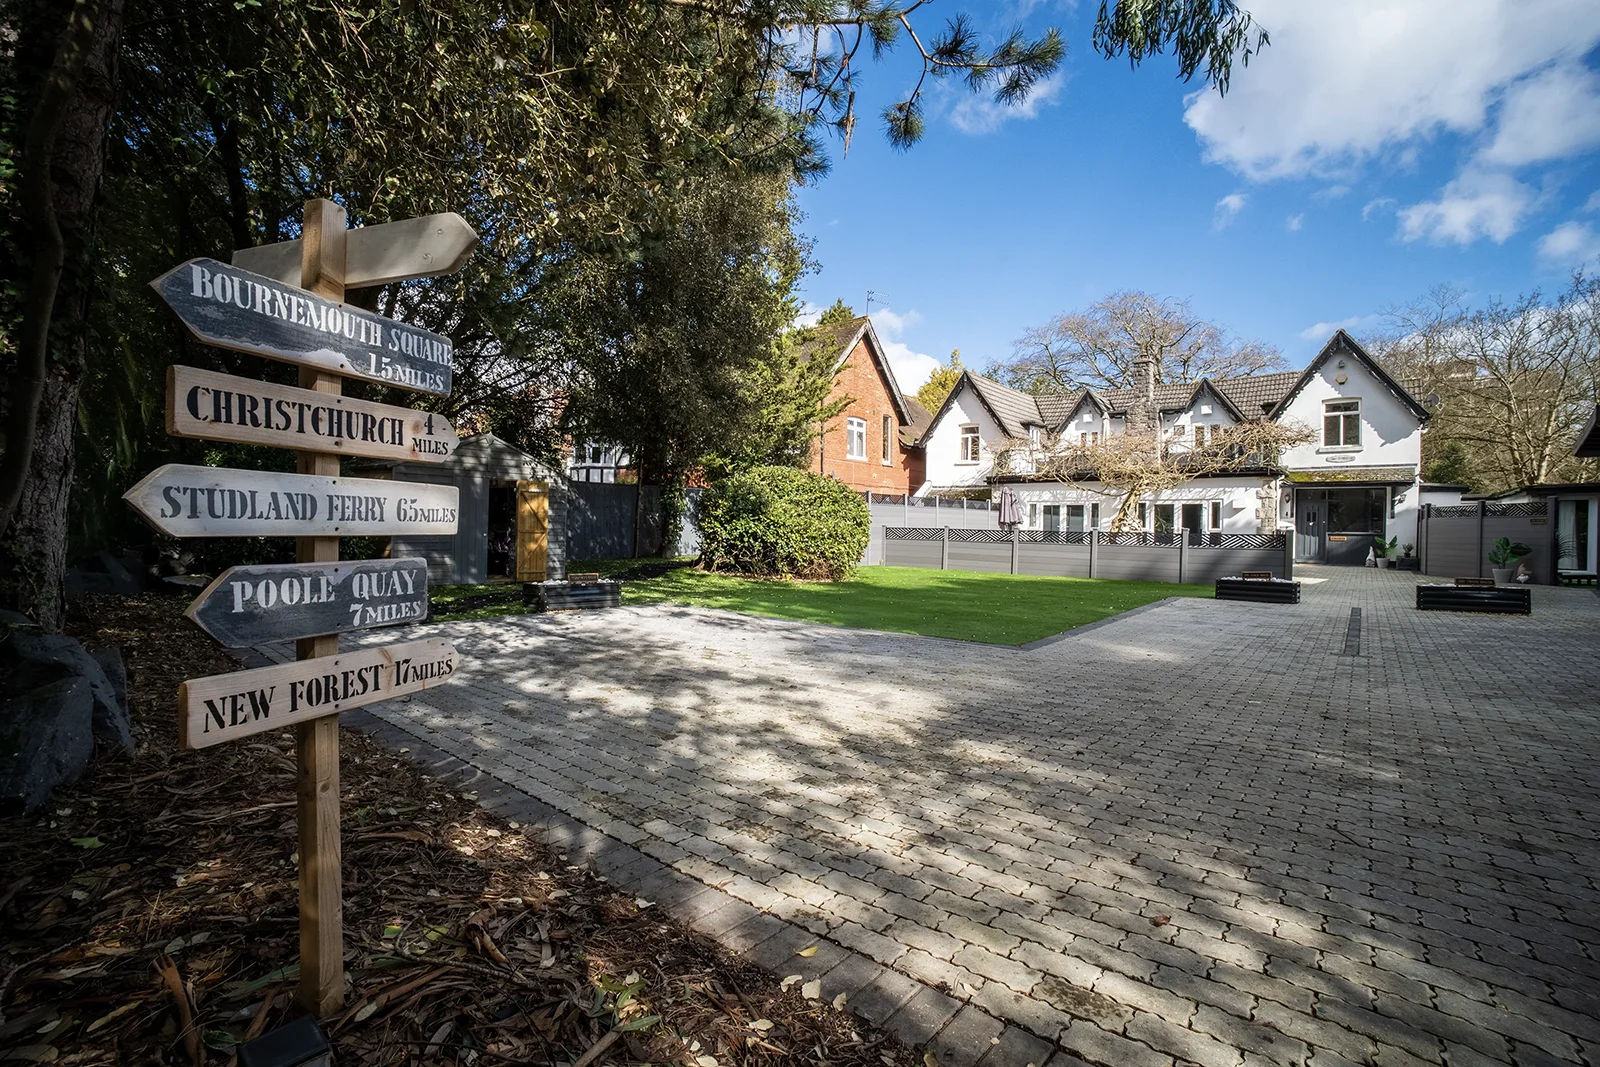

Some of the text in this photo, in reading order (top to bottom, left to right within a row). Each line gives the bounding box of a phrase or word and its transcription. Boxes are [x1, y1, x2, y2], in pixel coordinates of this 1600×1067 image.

[190, 263, 453, 366] BOURNEMOUTH SQUARE
[186, 385, 404, 446] CHRISTCHURCH
[424, 413, 435, 435] 4
[412, 437, 449, 456] MILES
[160, 485, 318, 520] STUDLAND
[326, 494, 387, 523] FERRY
[230, 569, 418, 613] POOLE QUAY
[203, 686, 277, 733] NEW
[289, 663, 384, 713] FOREST
